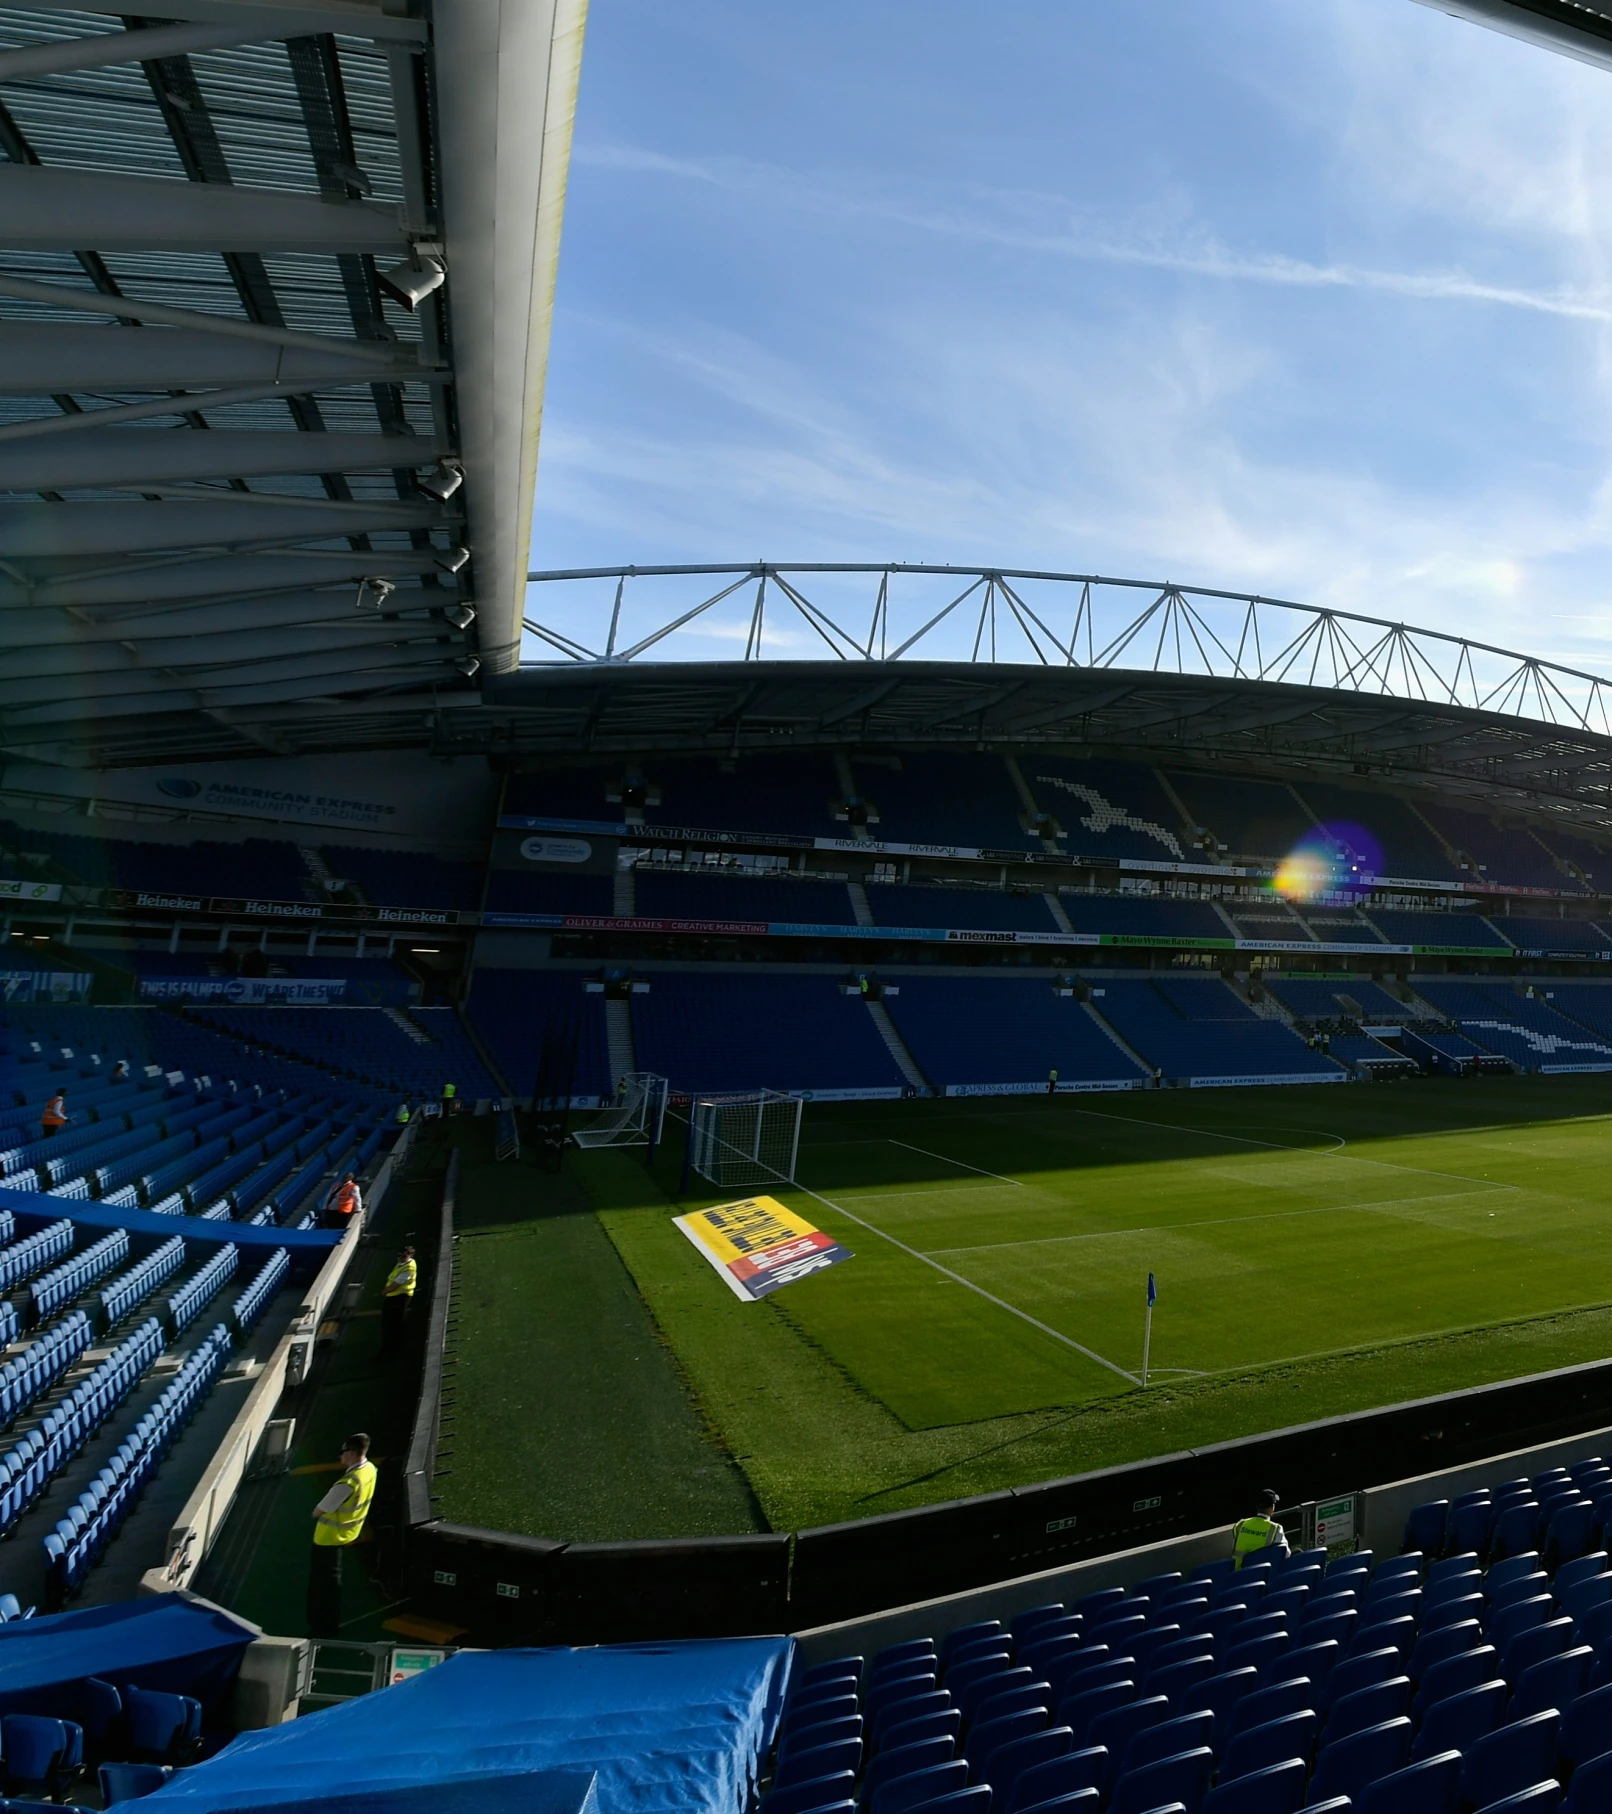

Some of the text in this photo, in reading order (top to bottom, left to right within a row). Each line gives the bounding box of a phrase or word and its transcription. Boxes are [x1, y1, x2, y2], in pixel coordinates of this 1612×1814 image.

[208, 782, 396, 815] AMERICAN EXPRESS
[205, 793, 379, 822] COMMUNITY STADIUM
[632, 825, 738, 843] WATCH RELIGION
[835, 839, 888, 850] RIVERVALE
[910, 844, 958, 855] RIVERVALE
[136, 893, 201, 910] Heineken
[245, 902, 322, 917] Heineken
[378, 908, 447, 923] Heineken
[566, 918, 605, 928] OLIVER
[616, 919, 662, 929] GRAIMES
[671, 922, 766, 933] CREATIVE MARKETING
[960, 931, 1017, 942] mexmast
[1122, 936, 1142, 945] Mayo
[1143, 937, 1170, 947] Wynne
[1171, 938, 1196, 946] Baxter
[140, 981, 167, 996] THIS
[167, 981, 177, 995] IS
[703, 1201, 769, 1229] BETTER
[747, 1238, 819, 1270] BET
[755, 1247, 838, 1290] sky
[1241, 1526, 1267, 1538] Steward
